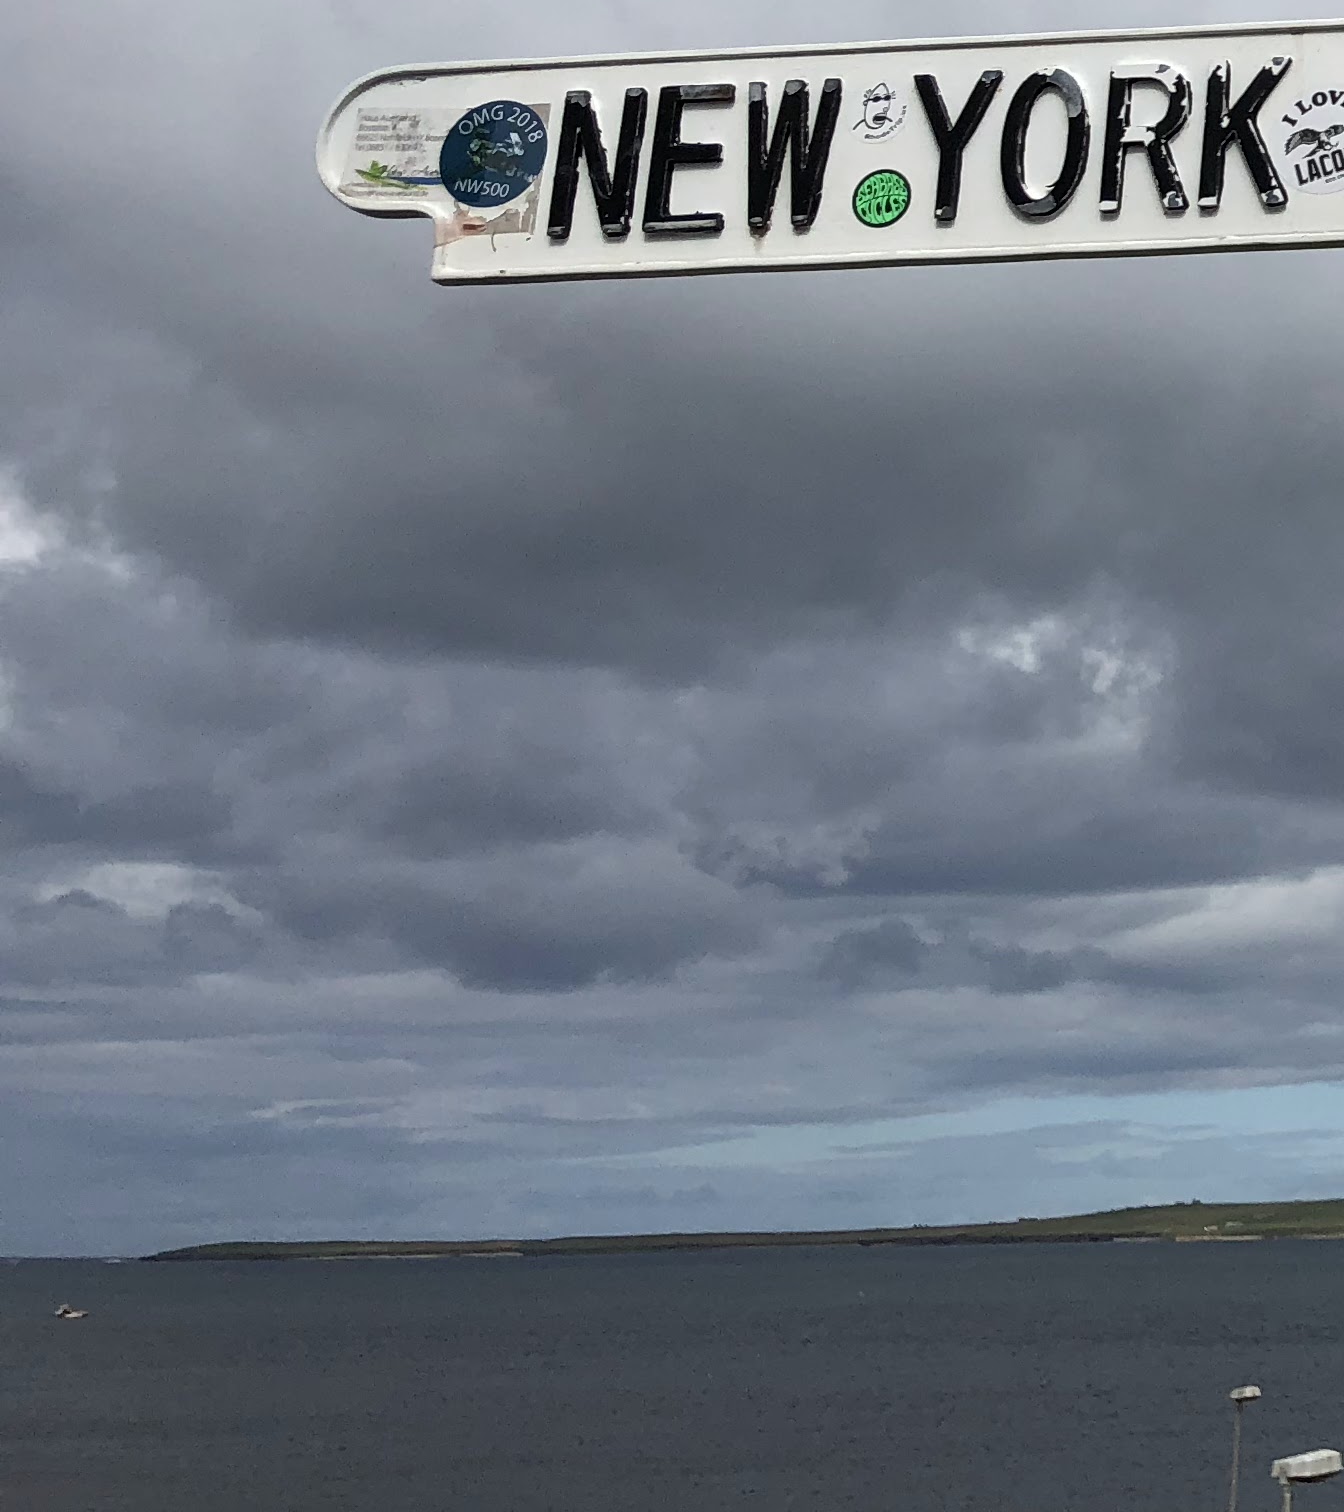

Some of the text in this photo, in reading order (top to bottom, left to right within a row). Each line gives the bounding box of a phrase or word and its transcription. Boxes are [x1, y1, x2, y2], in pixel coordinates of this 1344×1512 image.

[458, 104, 504, 136] OMG
[506, 106, 544, 143] 2018
[1281, 114, 1298, 128] I
[546, 76, 844, 241] NEW
[913, 55, 1294, 221] YORK
[454, 177, 511, 198] NW500
